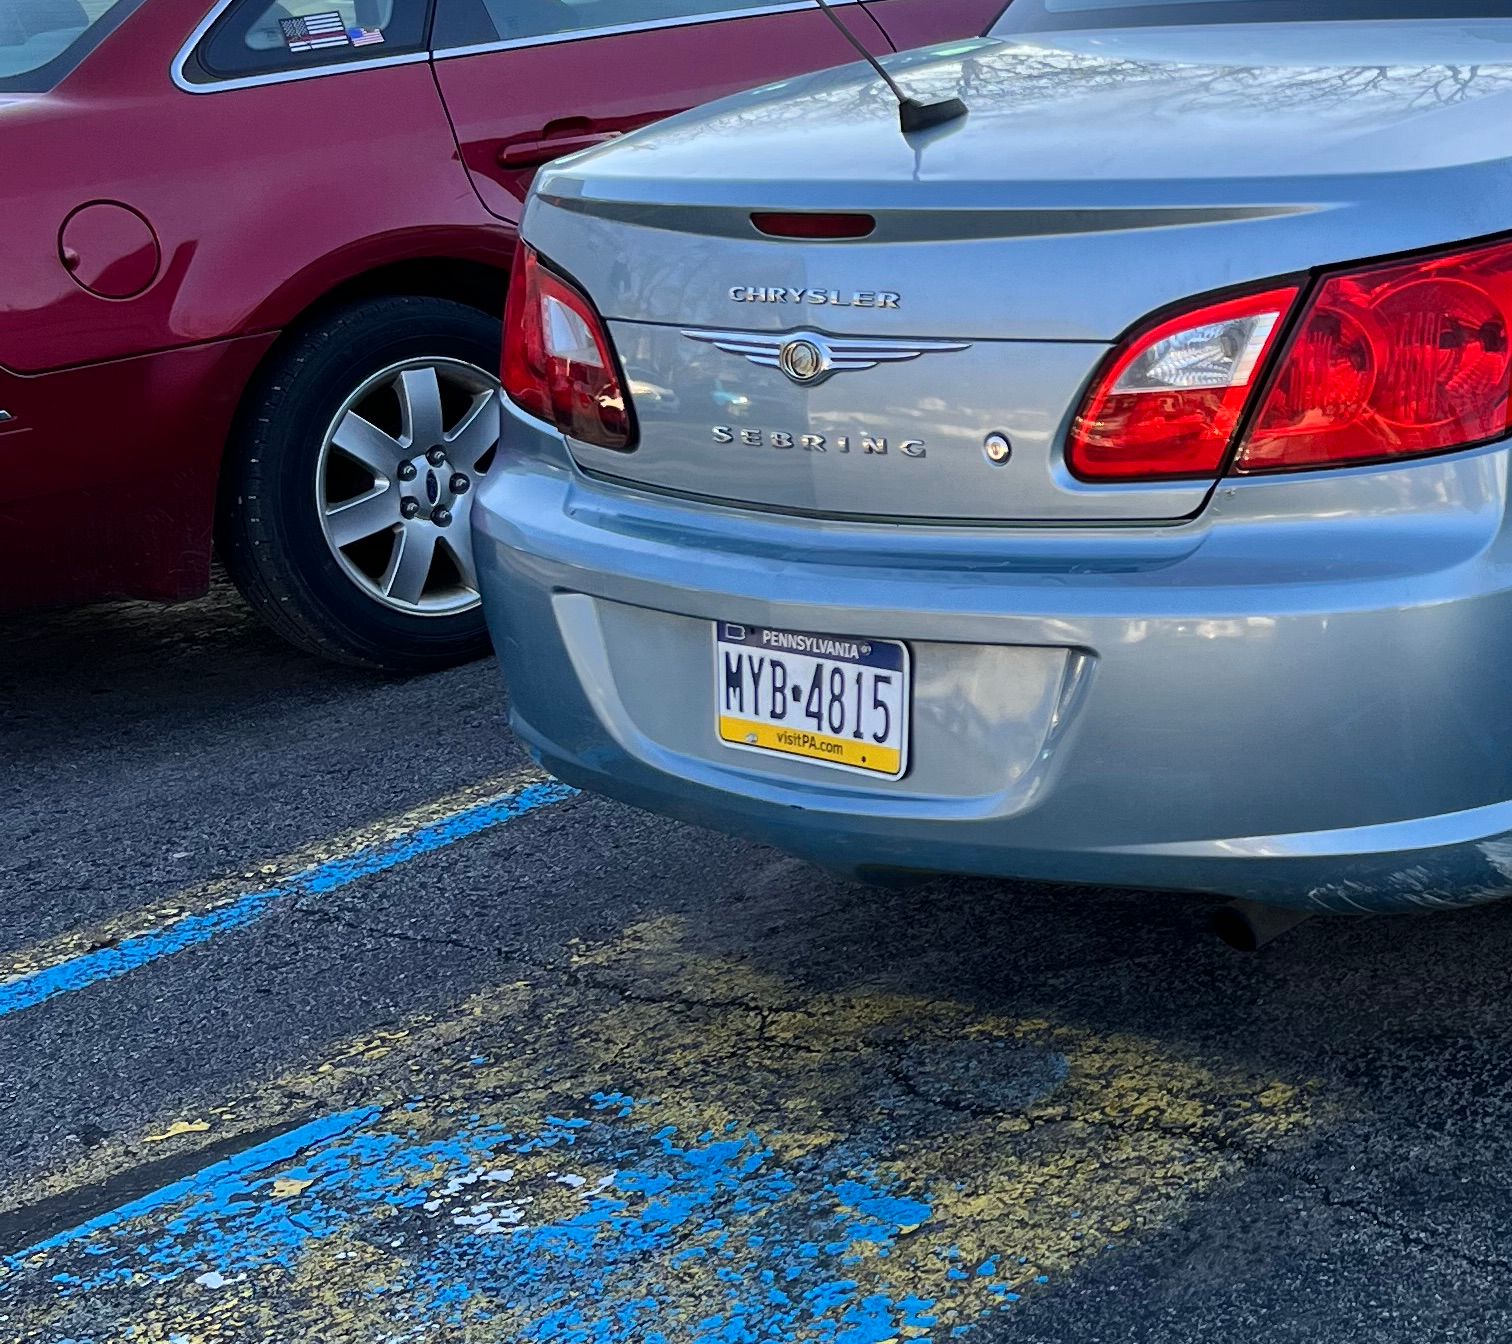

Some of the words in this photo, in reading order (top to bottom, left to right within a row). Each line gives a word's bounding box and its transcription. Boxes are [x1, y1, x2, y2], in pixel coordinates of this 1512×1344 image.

[728, 286, 901, 310] CHRYSLER
[711, 425, 928, 458] SEBRING
[762, 629, 860, 660] PENNSYLVANIA
[776, 731, 844, 755] visitPA.com
